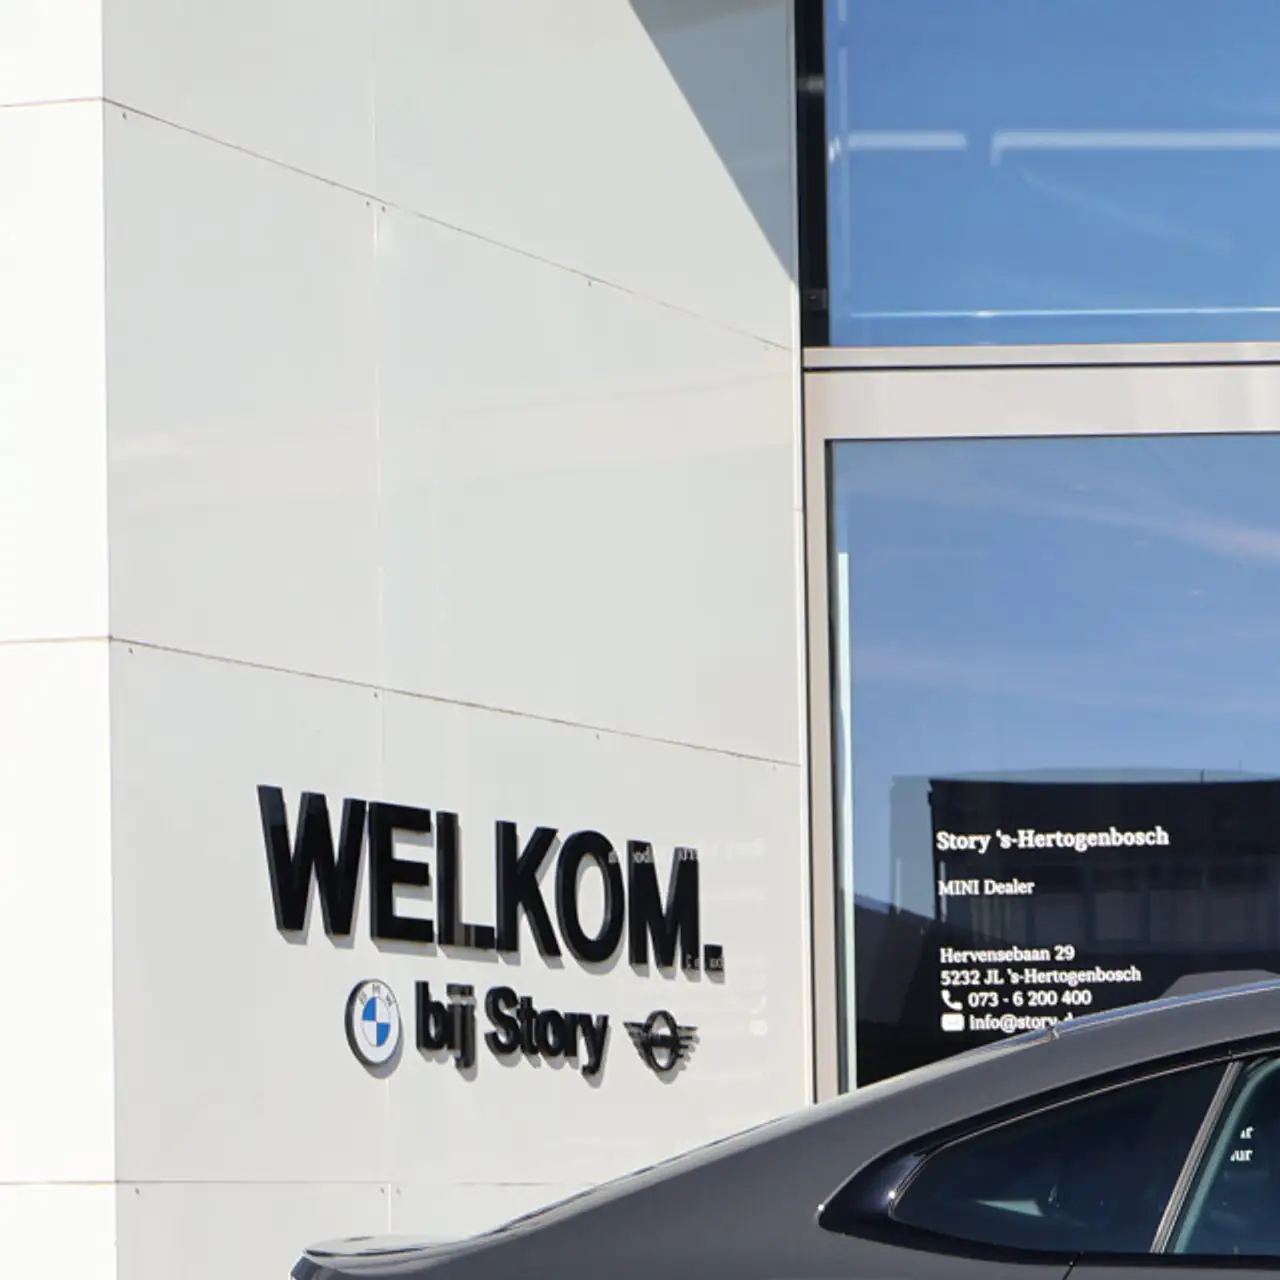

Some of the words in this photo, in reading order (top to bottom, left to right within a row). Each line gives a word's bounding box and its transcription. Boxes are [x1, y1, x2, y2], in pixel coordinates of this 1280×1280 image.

[936, 831, 991, 854] Story
[256, 784, 725, 973] WELKOM.
[938, 880, 980, 896] MINI
[983, 877, 1036, 896] Dealer
[939, 945, 1051, 964] Hervensebaan
[1053, 944, 1076, 962] 29
[940, 969, 981, 987] 5232
[983, 968, 1005, 986] JL
[967, 991, 1000, 1008] 073
[1012, 990, 1025, 1007] 6
[1027, 989, 1059, 1007] 200
[1060, 989, 1093, 1006] 400
[414, 980, 474, 1070] bij
[485, 986, 608, 1077] Story
